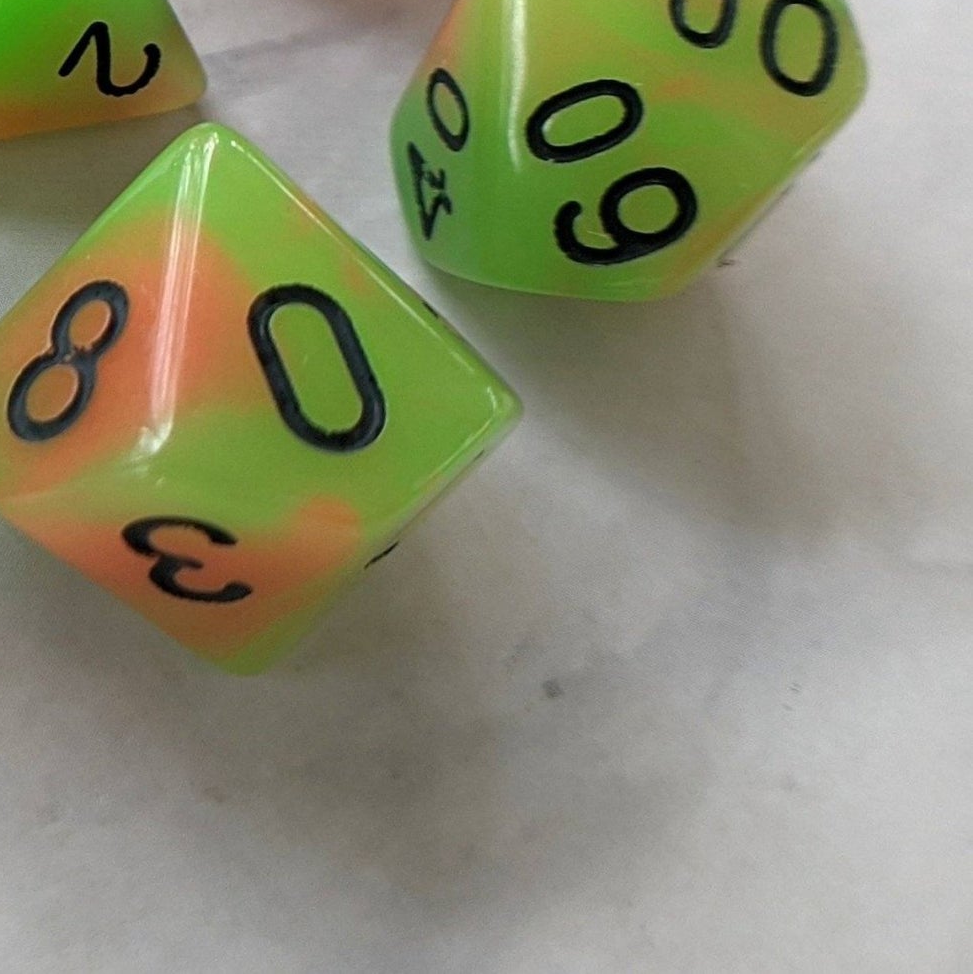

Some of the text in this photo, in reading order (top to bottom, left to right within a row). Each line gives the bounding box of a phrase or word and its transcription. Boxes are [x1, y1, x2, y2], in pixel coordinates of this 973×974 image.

[58, 22, 161, 97] 2
[7, 281, 128, 442] 8
[248, 284, 386, 453] 0
[123, 517, 252, 603] 3
